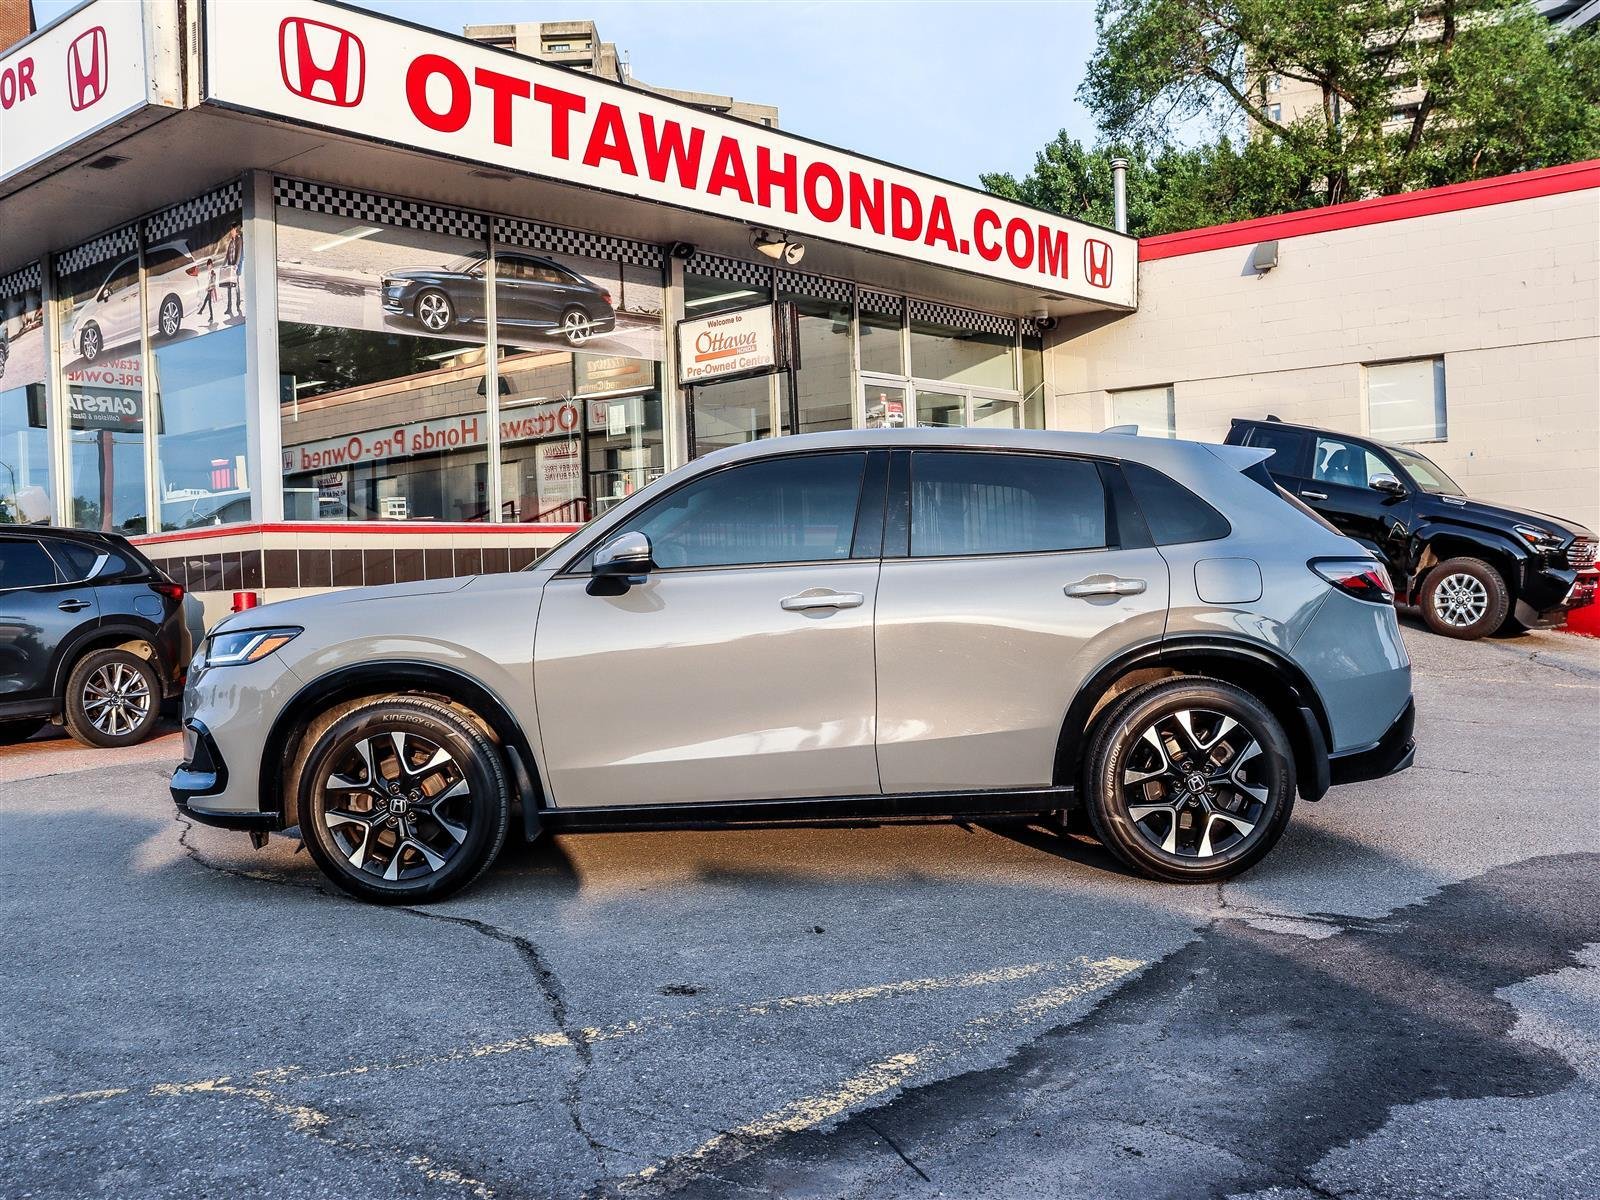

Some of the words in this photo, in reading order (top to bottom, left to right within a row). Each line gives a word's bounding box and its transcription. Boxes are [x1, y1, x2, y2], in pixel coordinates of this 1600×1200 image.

[405, 53, 1069, 280] OTTAWAHONDA.COM
[707, 317, 735, 328] Welcome
[695, 331, 757, 354] Ottawa
[686, 359, 737, 377] Pre-Owned
[739, 355, 771, 368] Centre
